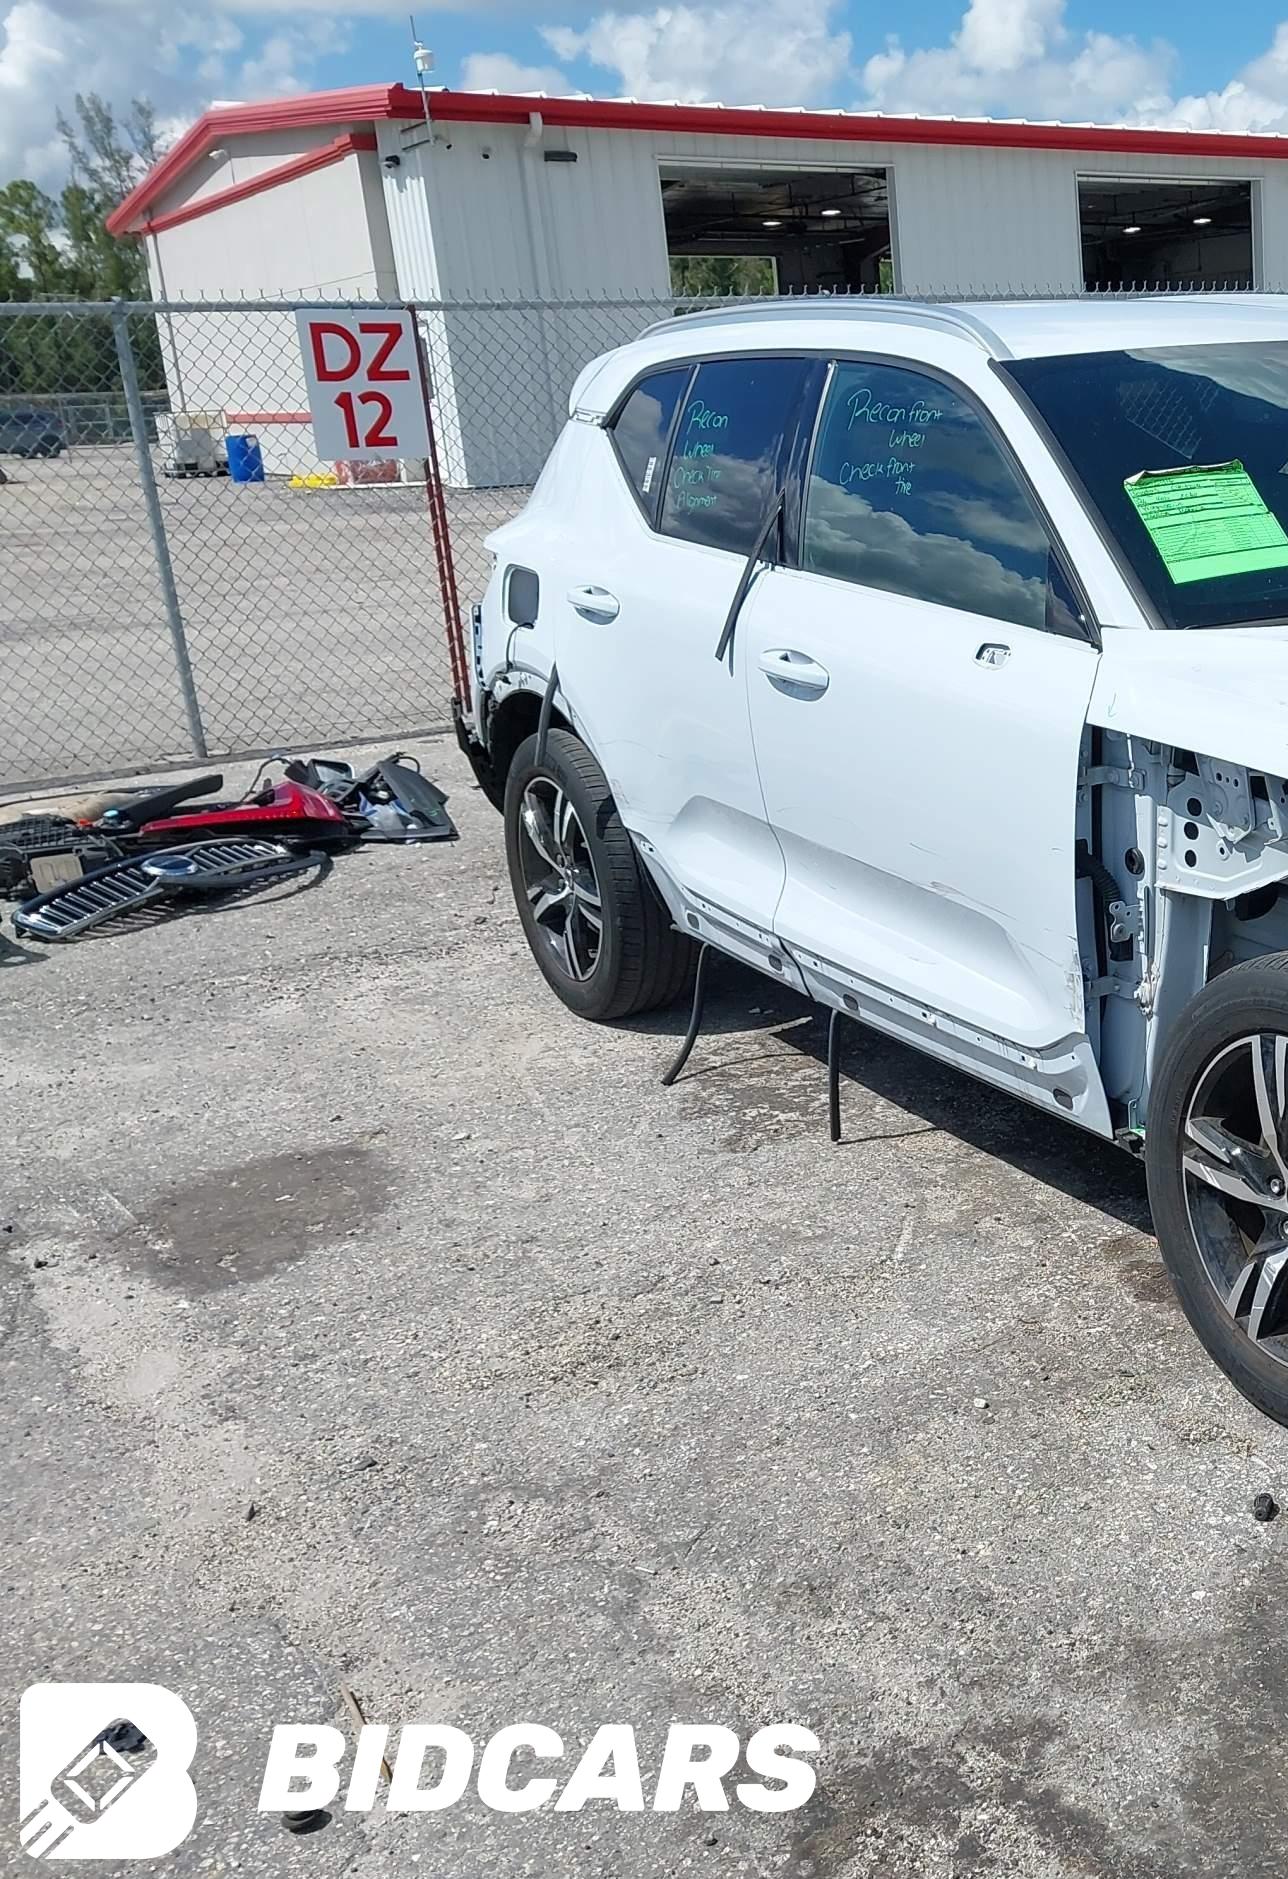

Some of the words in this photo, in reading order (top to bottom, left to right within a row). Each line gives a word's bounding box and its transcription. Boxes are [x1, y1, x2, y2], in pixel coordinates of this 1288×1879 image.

[309, 322, 411, 382] DZ
[333, 390, 398, 449] 12
[687, 400, 729, 435] Recon
[847, 388, 905, 431] Recon
[908, 400, 943, 423] front
[886, 456, 916, 478] front
